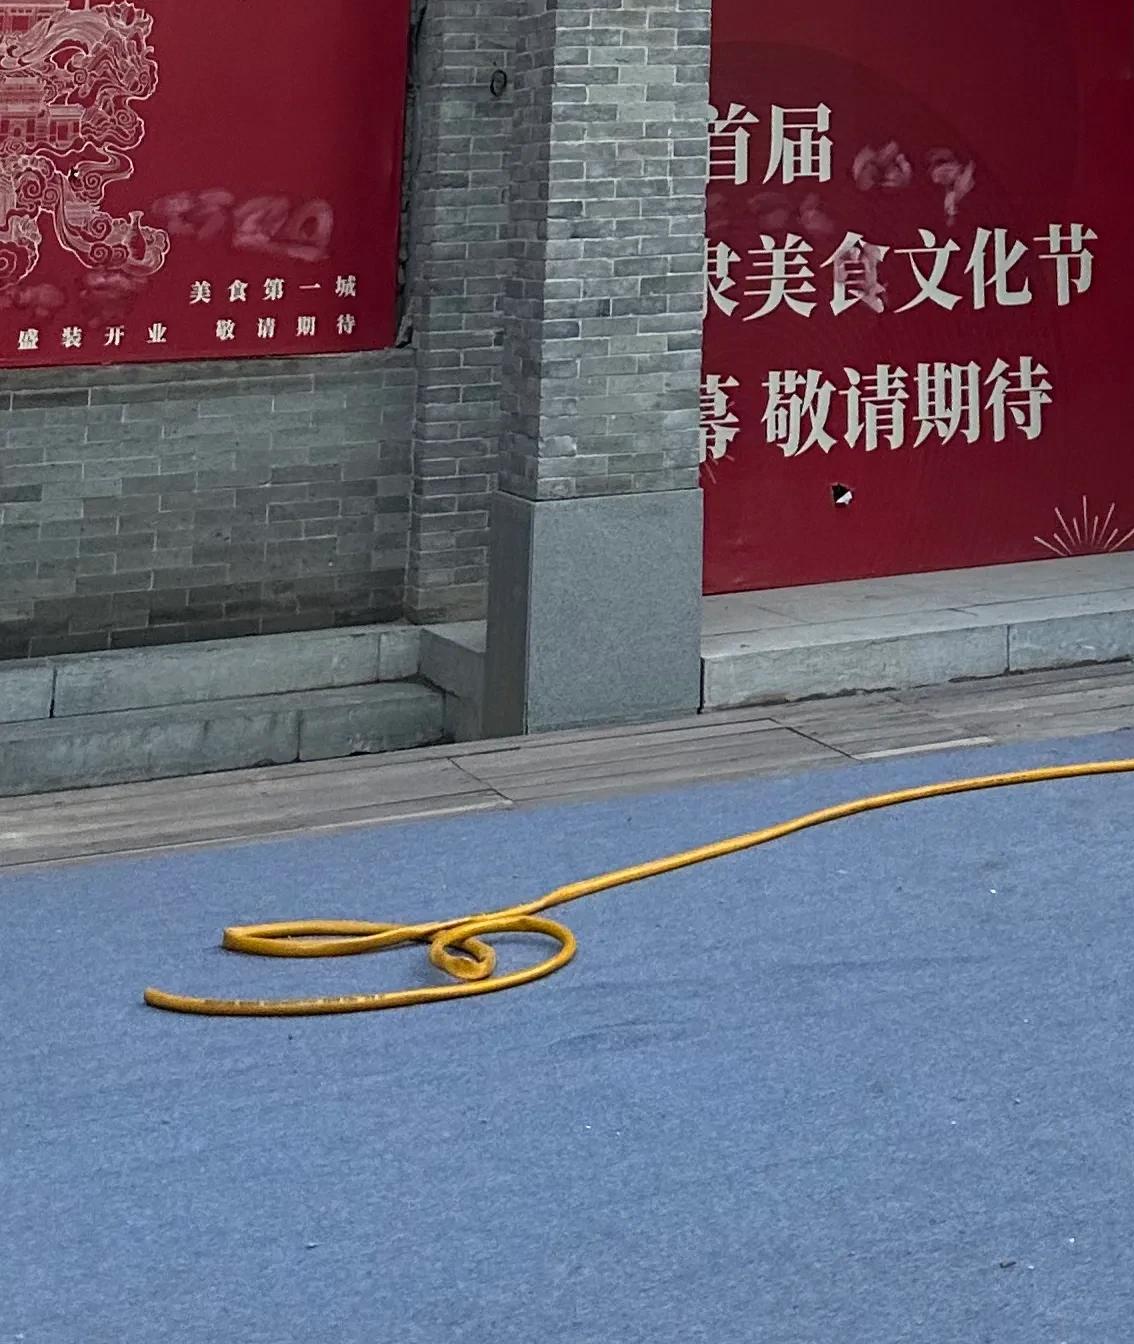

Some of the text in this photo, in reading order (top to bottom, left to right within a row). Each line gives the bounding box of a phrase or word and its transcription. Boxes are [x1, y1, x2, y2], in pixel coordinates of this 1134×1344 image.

[190, 275, 357, 304] 美食第一城
[17, 314, 356, 351] 盛装开业 敬请期待
[761, 356, 1054, 457] 敬请期待
